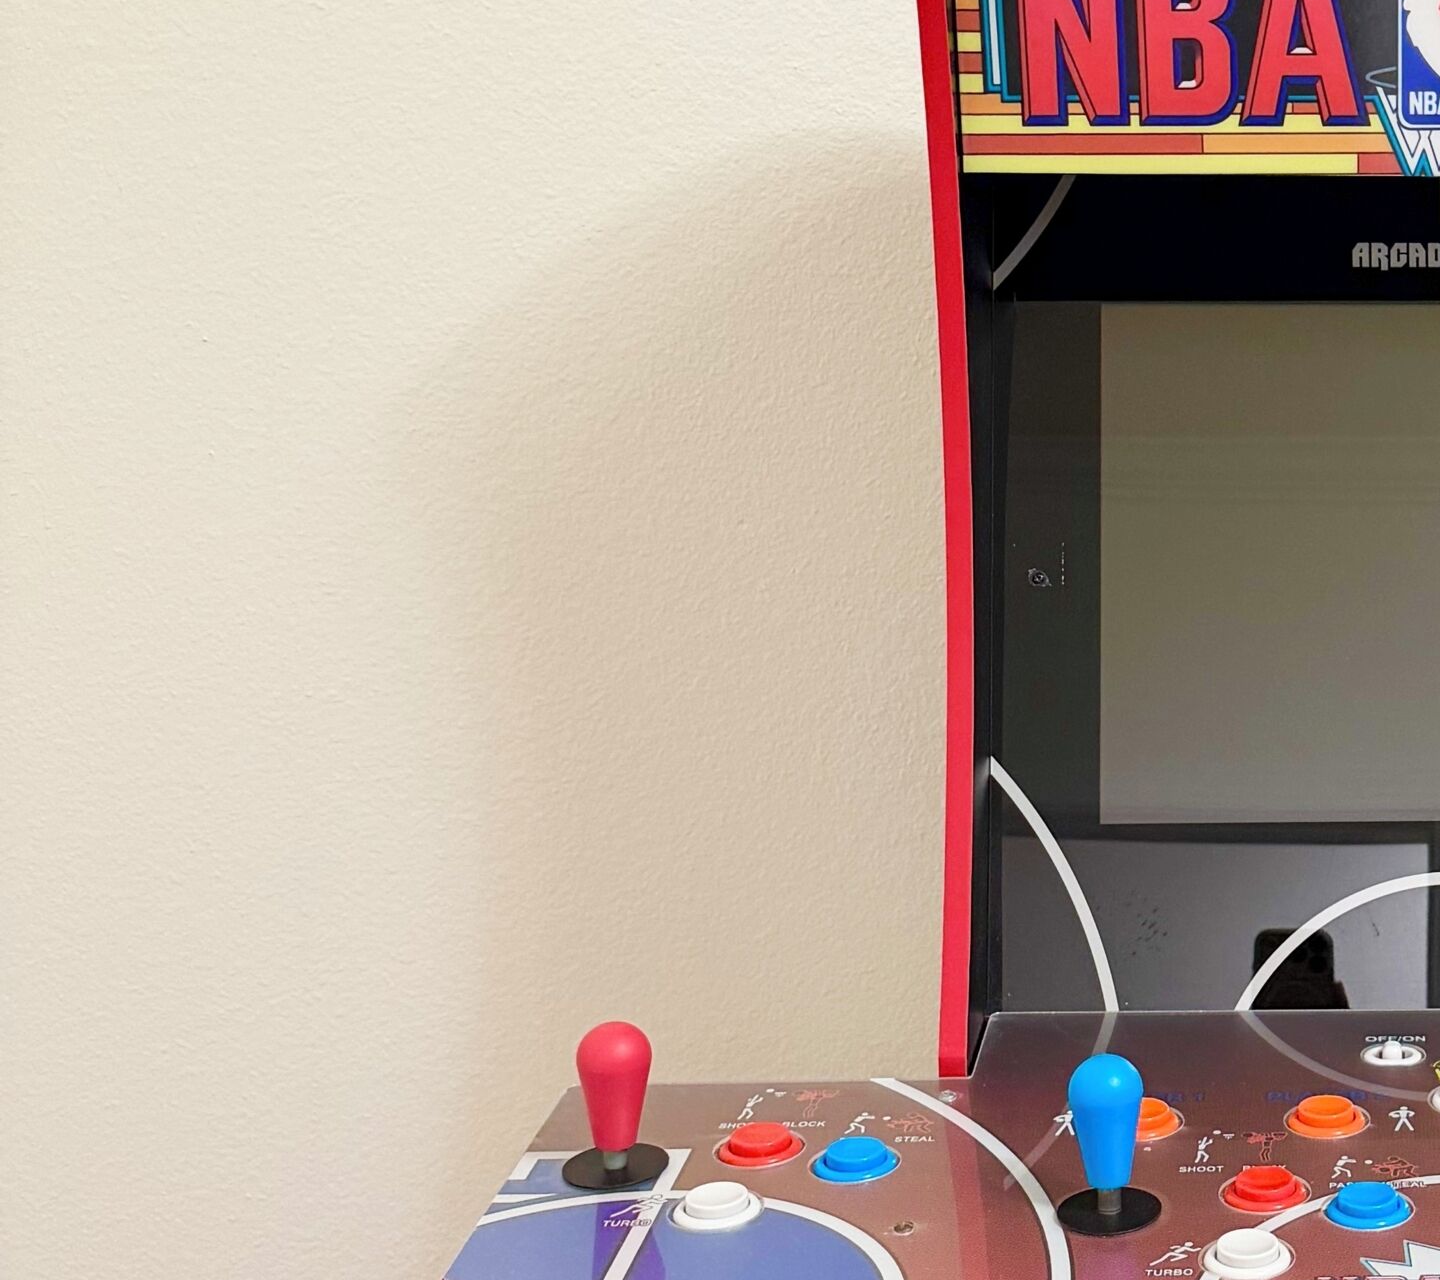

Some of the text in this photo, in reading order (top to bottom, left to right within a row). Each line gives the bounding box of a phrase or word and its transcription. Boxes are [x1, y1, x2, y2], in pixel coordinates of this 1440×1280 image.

[894, 1135, 936, 1143] STEAL
[1179, 1165, 1224, 1173] SHOOT
[1145, 1268, 1194, 1277] TURBO
